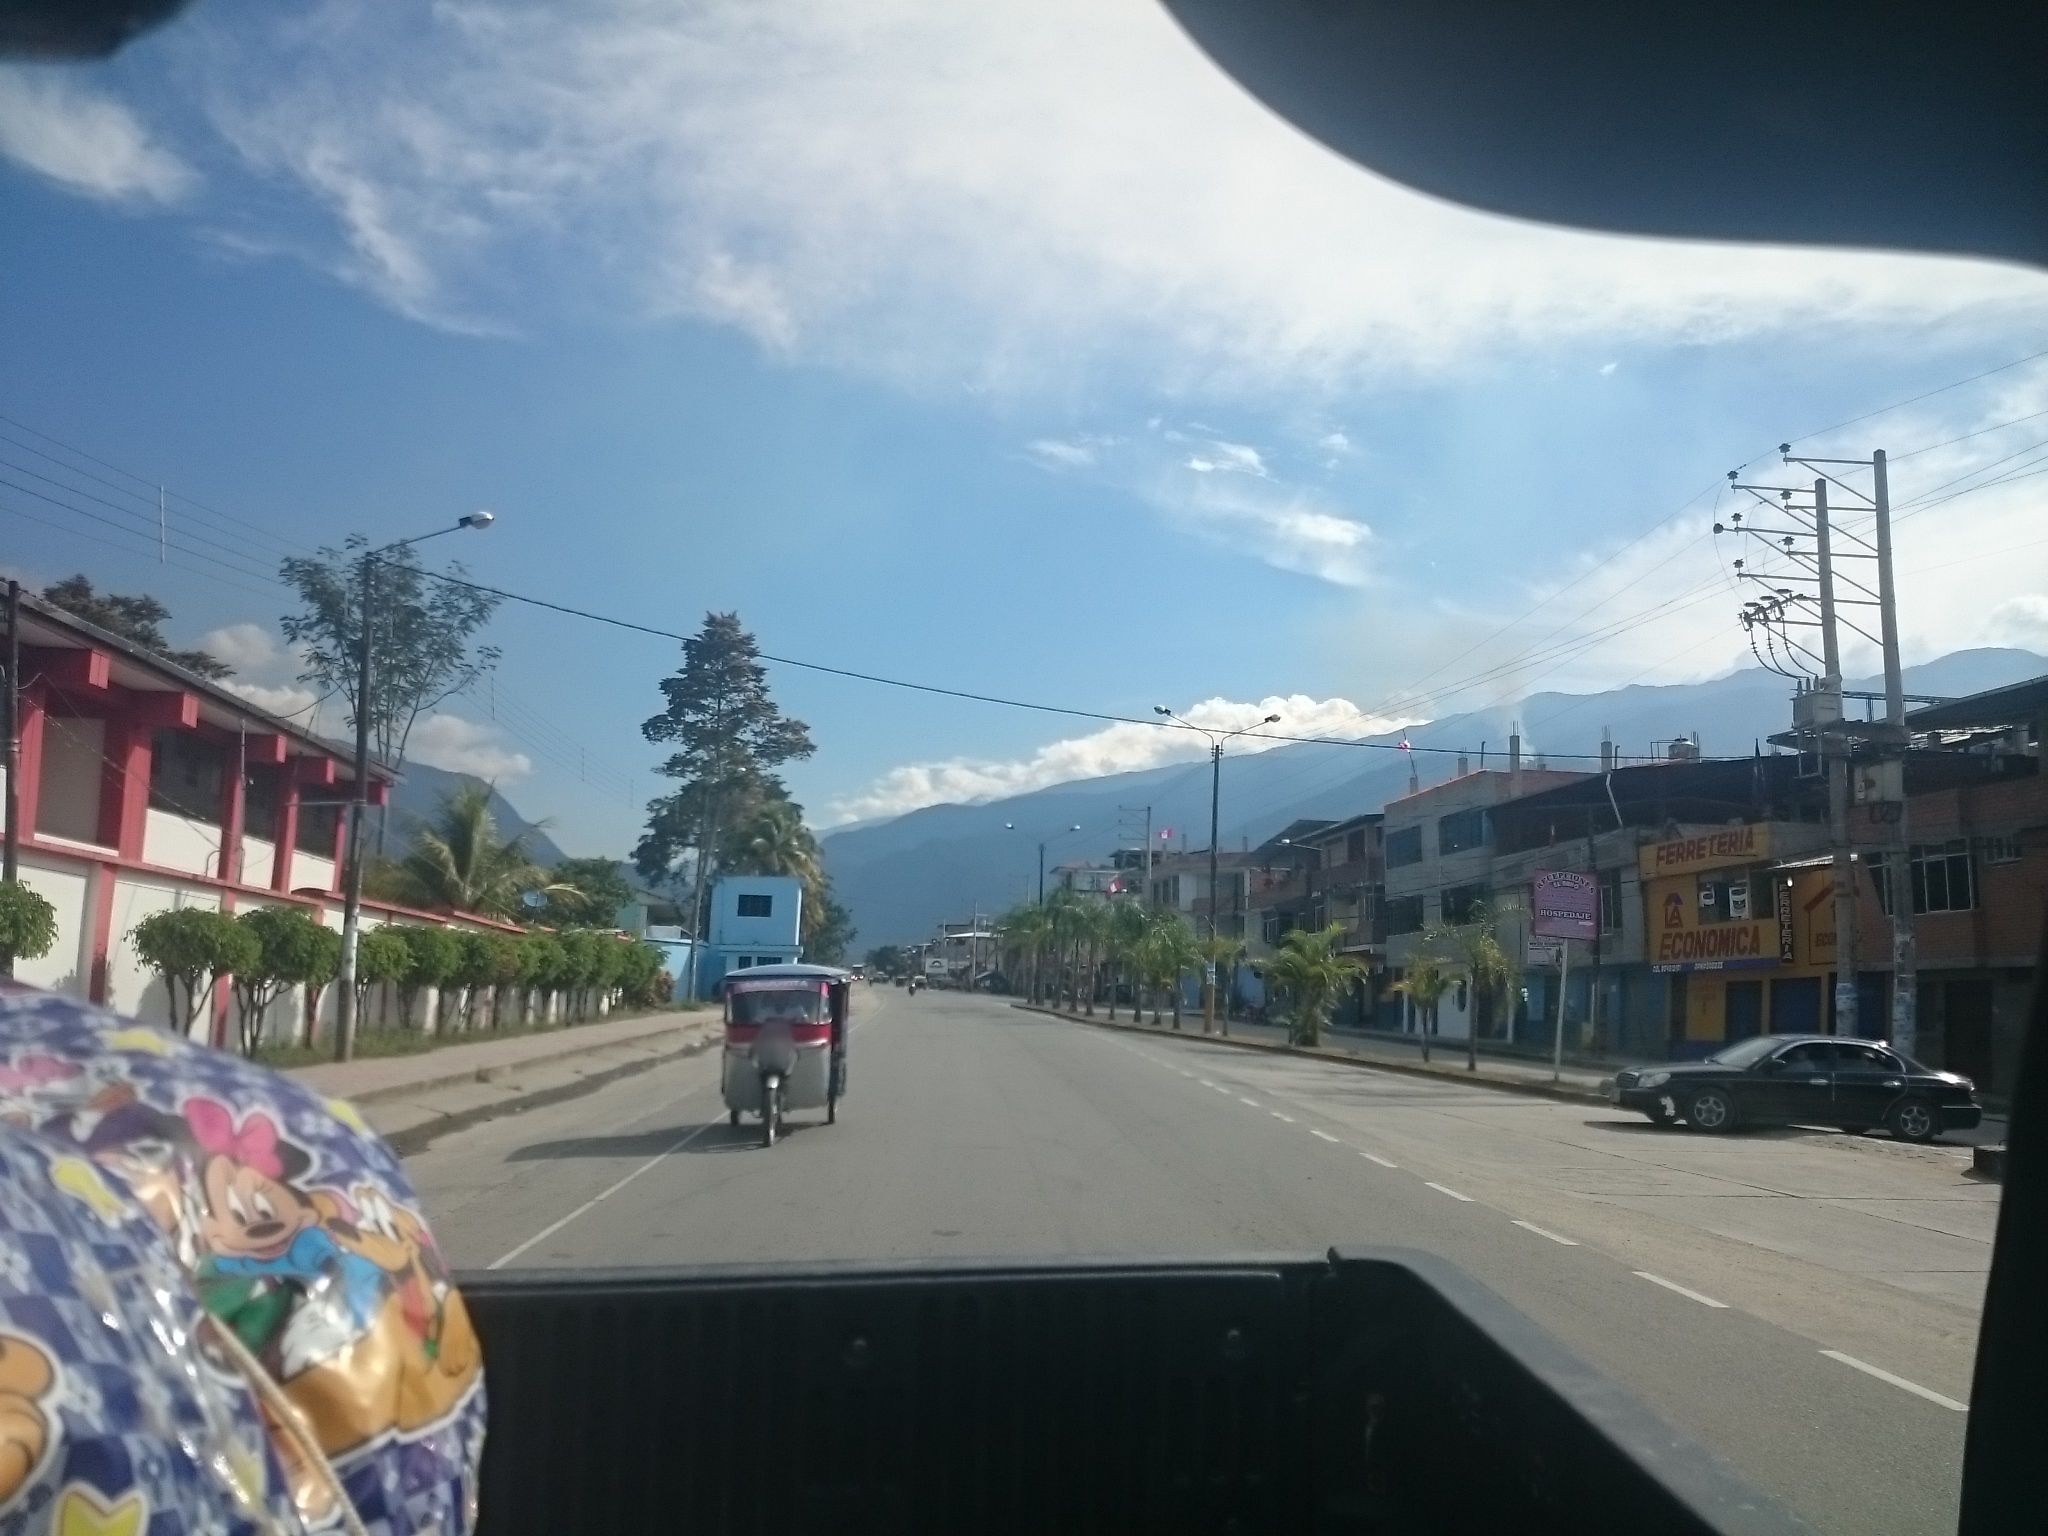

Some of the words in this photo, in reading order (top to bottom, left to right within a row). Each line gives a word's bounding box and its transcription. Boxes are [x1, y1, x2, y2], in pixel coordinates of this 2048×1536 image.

[1656, 827, 1754, 866] FERRETERIA
[1536, 872, 1594, 895] RECEPCIONES
[1540, 909, 1591, 921] HOSPEDAJE
[1664, 905, 1683, 928] LA
[1779, 884, 1793, 960] FERRETERIA
[1659, 926, 1760, 960] ECONOMICA
